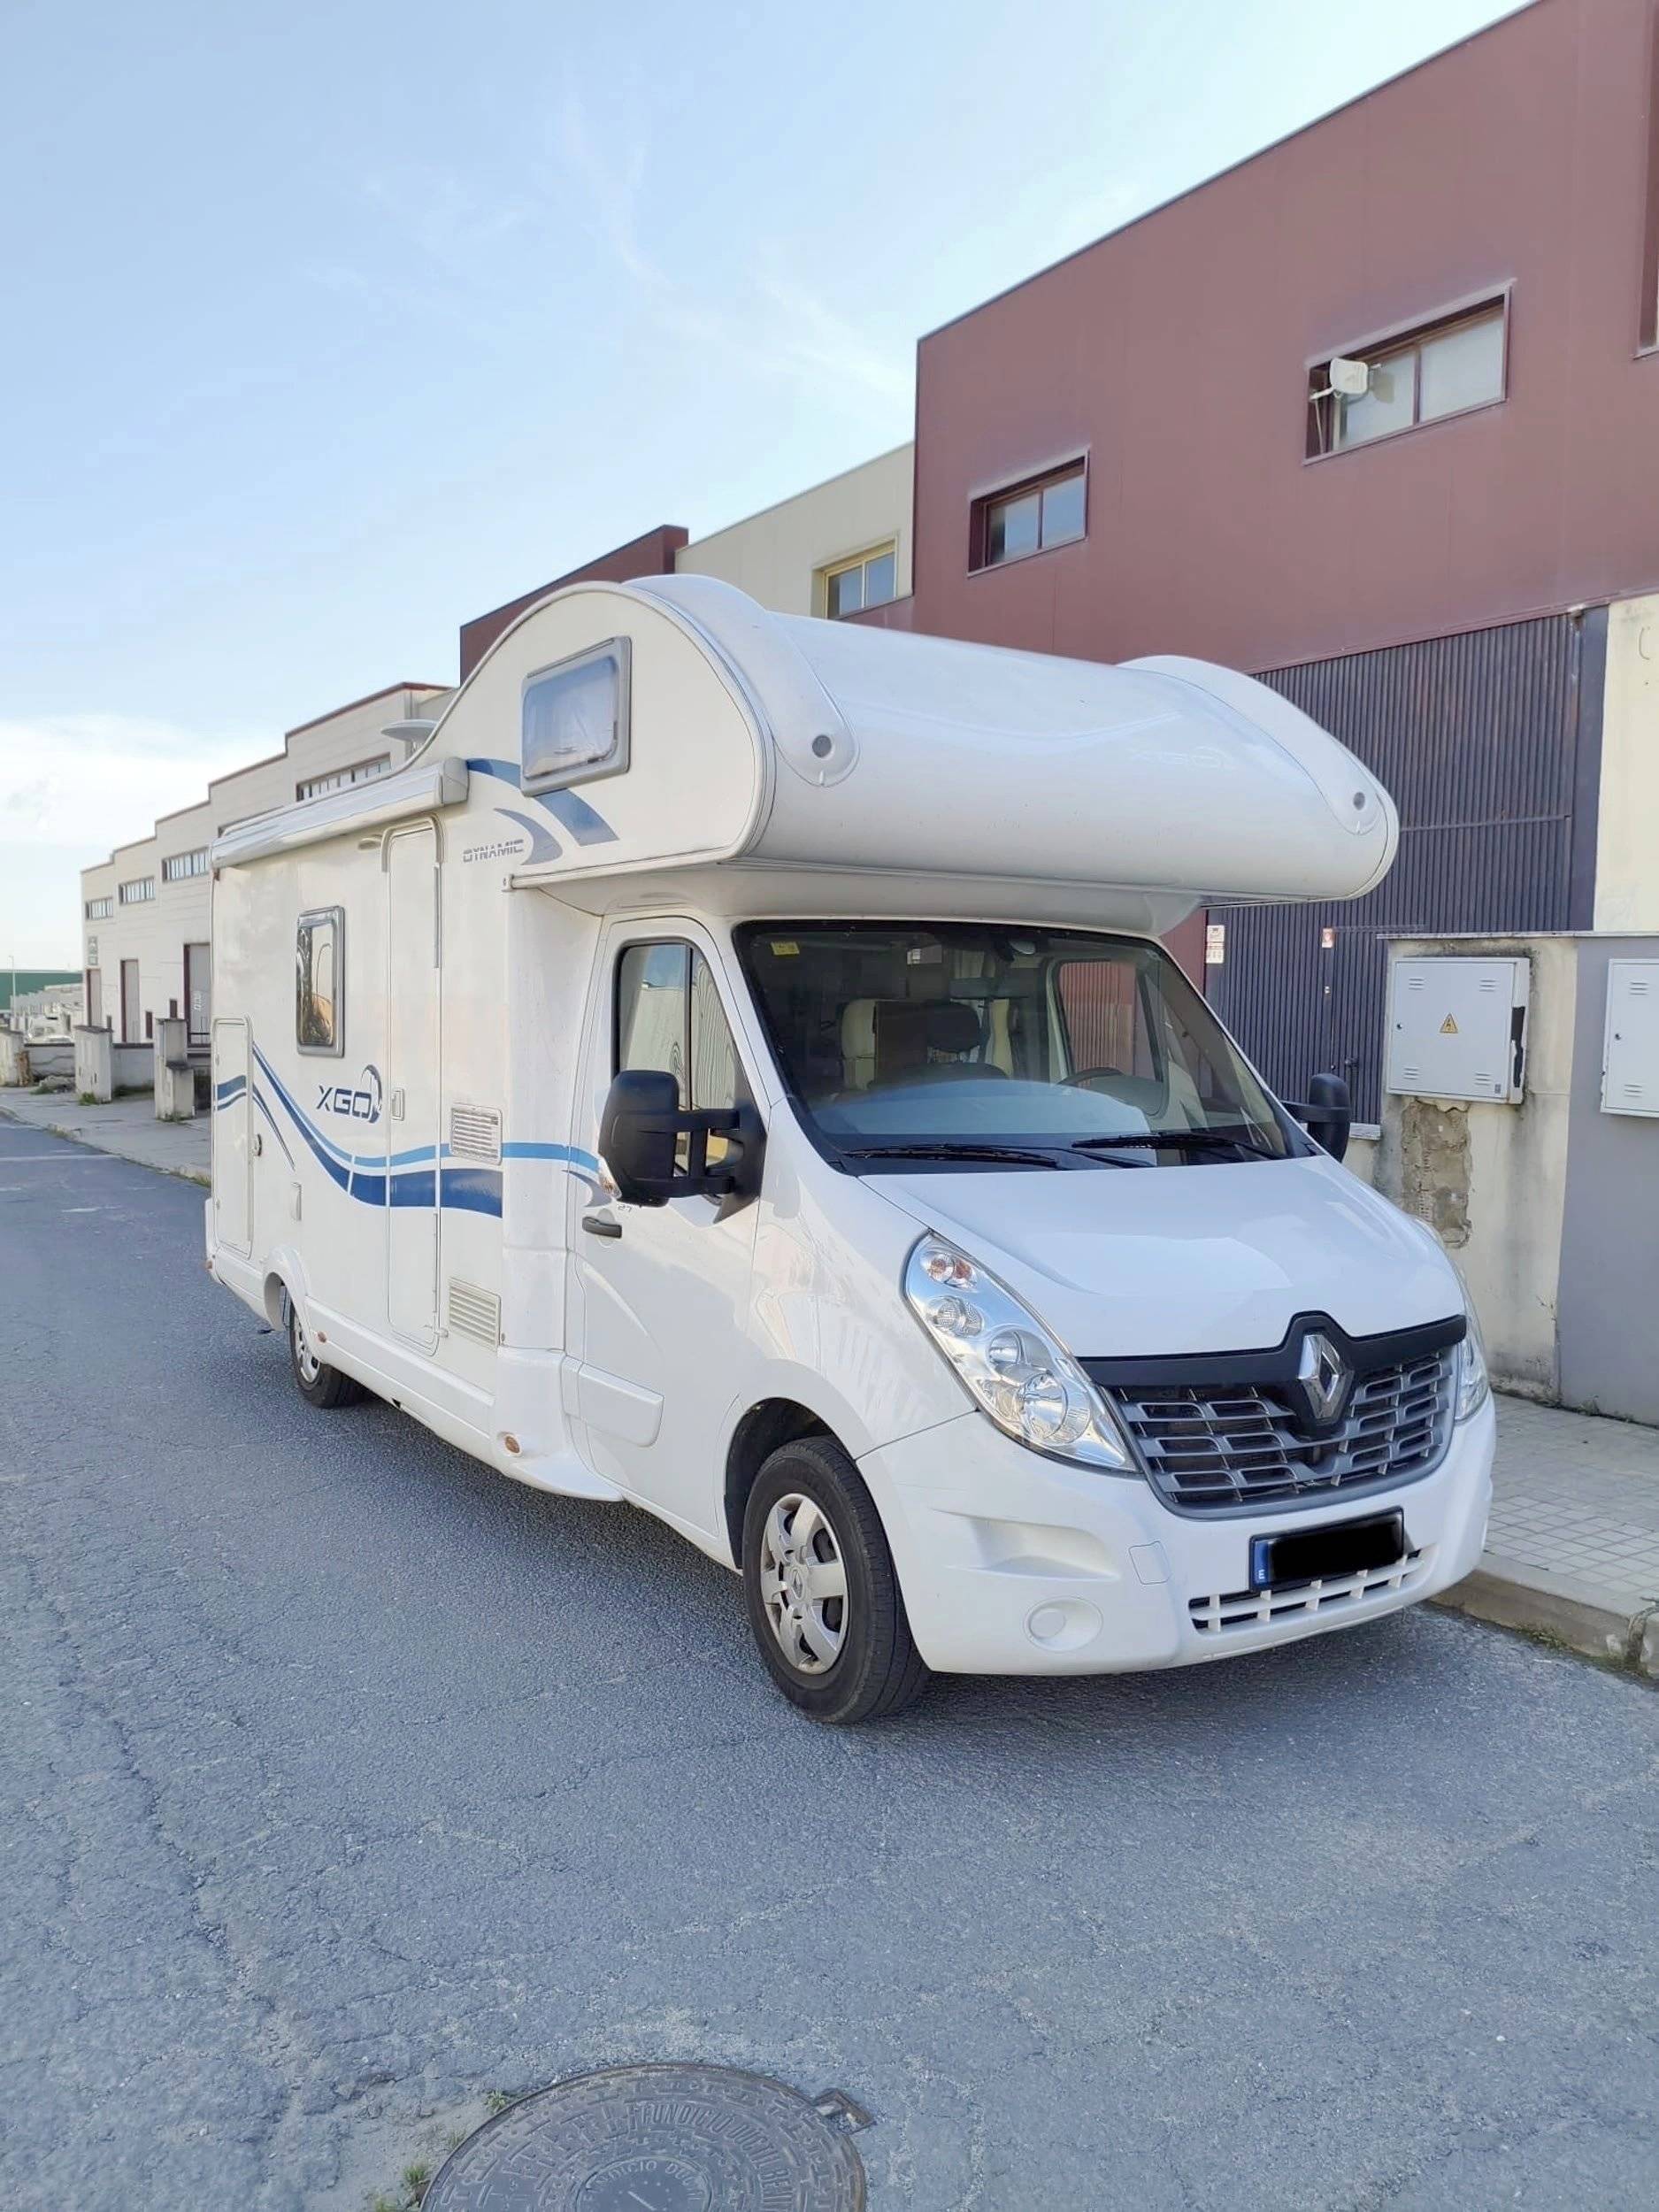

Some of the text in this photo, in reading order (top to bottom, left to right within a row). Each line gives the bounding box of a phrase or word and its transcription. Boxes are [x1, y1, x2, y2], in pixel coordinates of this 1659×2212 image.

[463, 839, 524, 863] DYNAMIC
[316, 1084, 373, 1119] XGO
[1259, 1569, 1265, 1580] E
